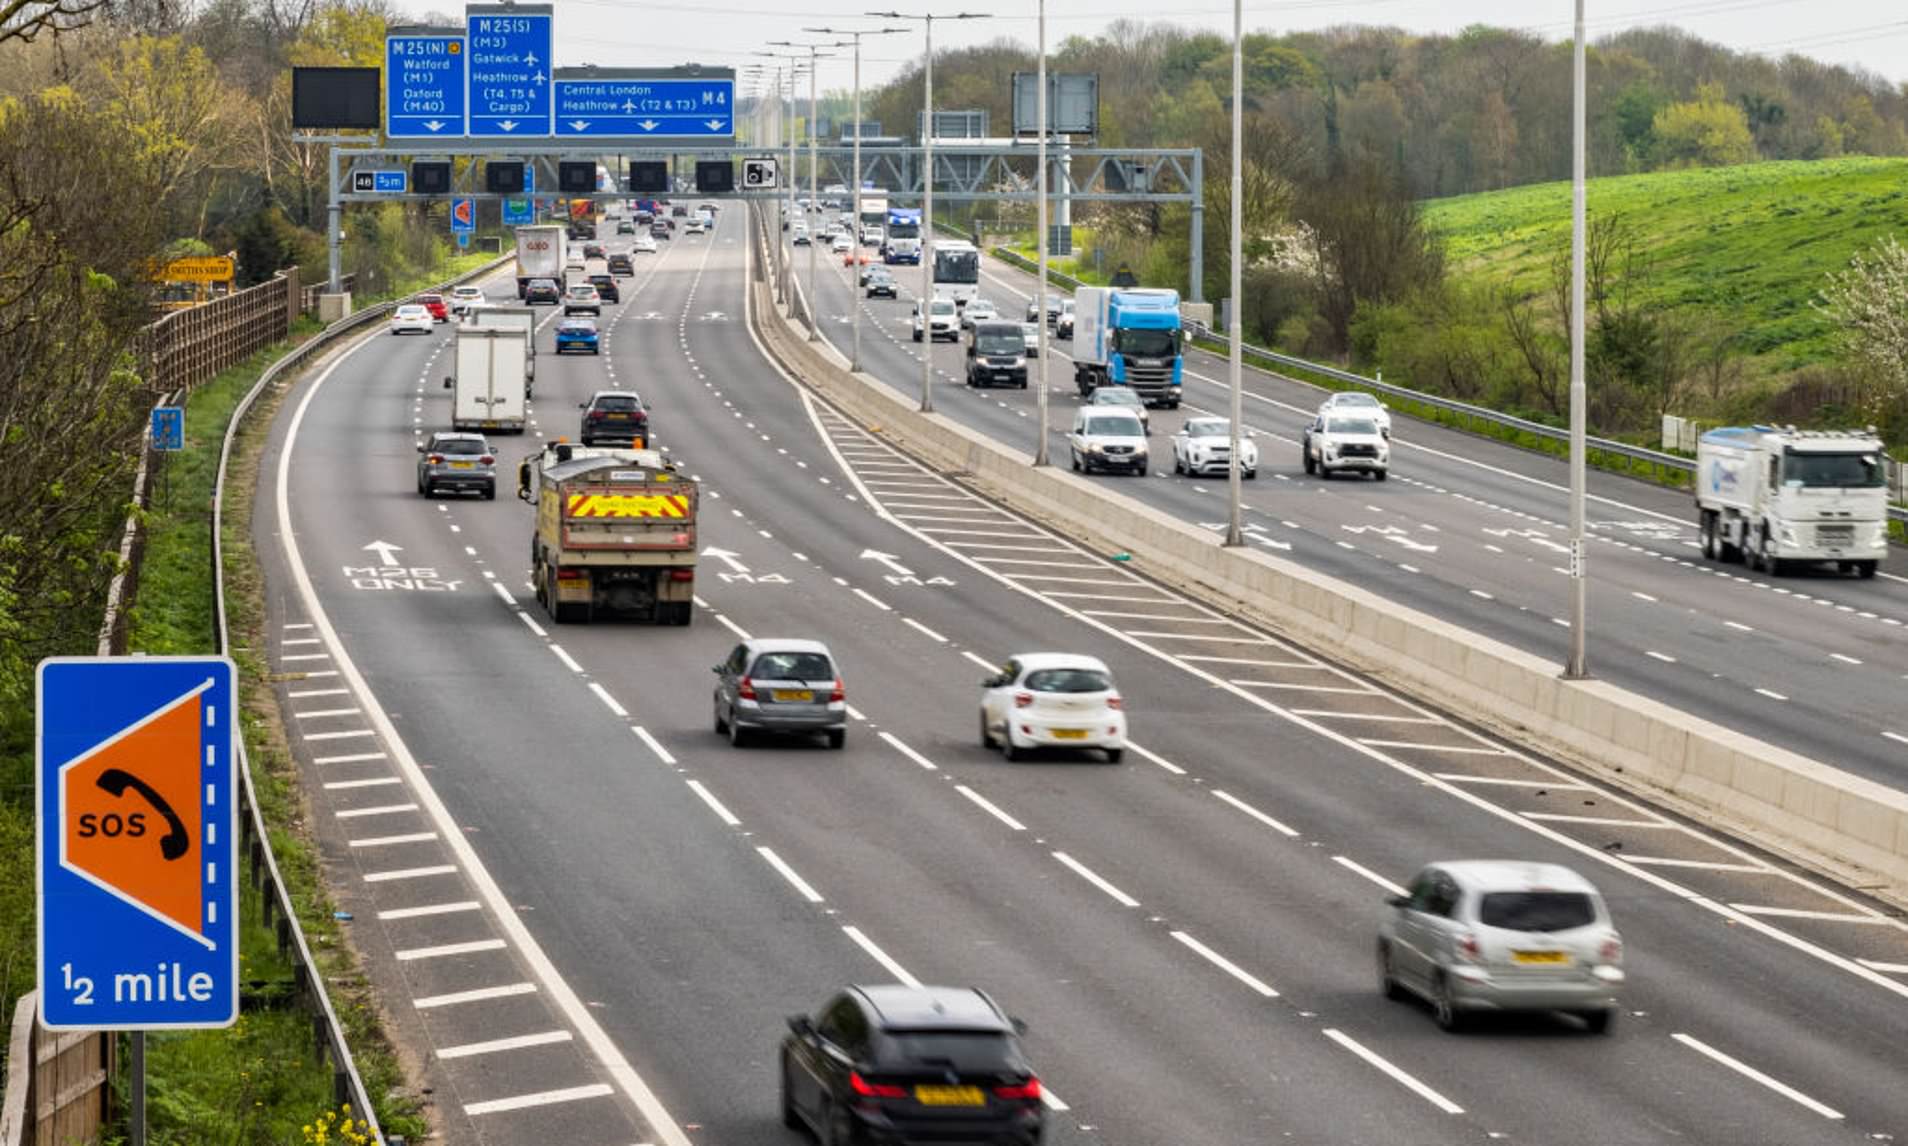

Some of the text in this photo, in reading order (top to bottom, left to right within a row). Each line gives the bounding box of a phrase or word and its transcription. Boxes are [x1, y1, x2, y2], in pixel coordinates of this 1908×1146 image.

[473, 36, 507, 49] (M3)
[403, 59, 450, 70] Watford
[473, 53, 520, 64] Gatwick
[473, 72, 529, 83] Heathrow
[403, 88, 443, 99] Oxford
[510, 88, 525, 100] T5
[528, 88, 537, 99] &
[563, 85, 652, 96] Central London
[702, 91, 726, 105] M4
[403, 100, 445, 113] (M40)
[489, 100, 530, 114] Cargo)
[563, 99, 698, 111] Heathrow (T2 & T3)
[352, 578, 464, 591] ONLY
[78, 813, 147, 838] SOS
[115, 962, 214, 1002] mile
